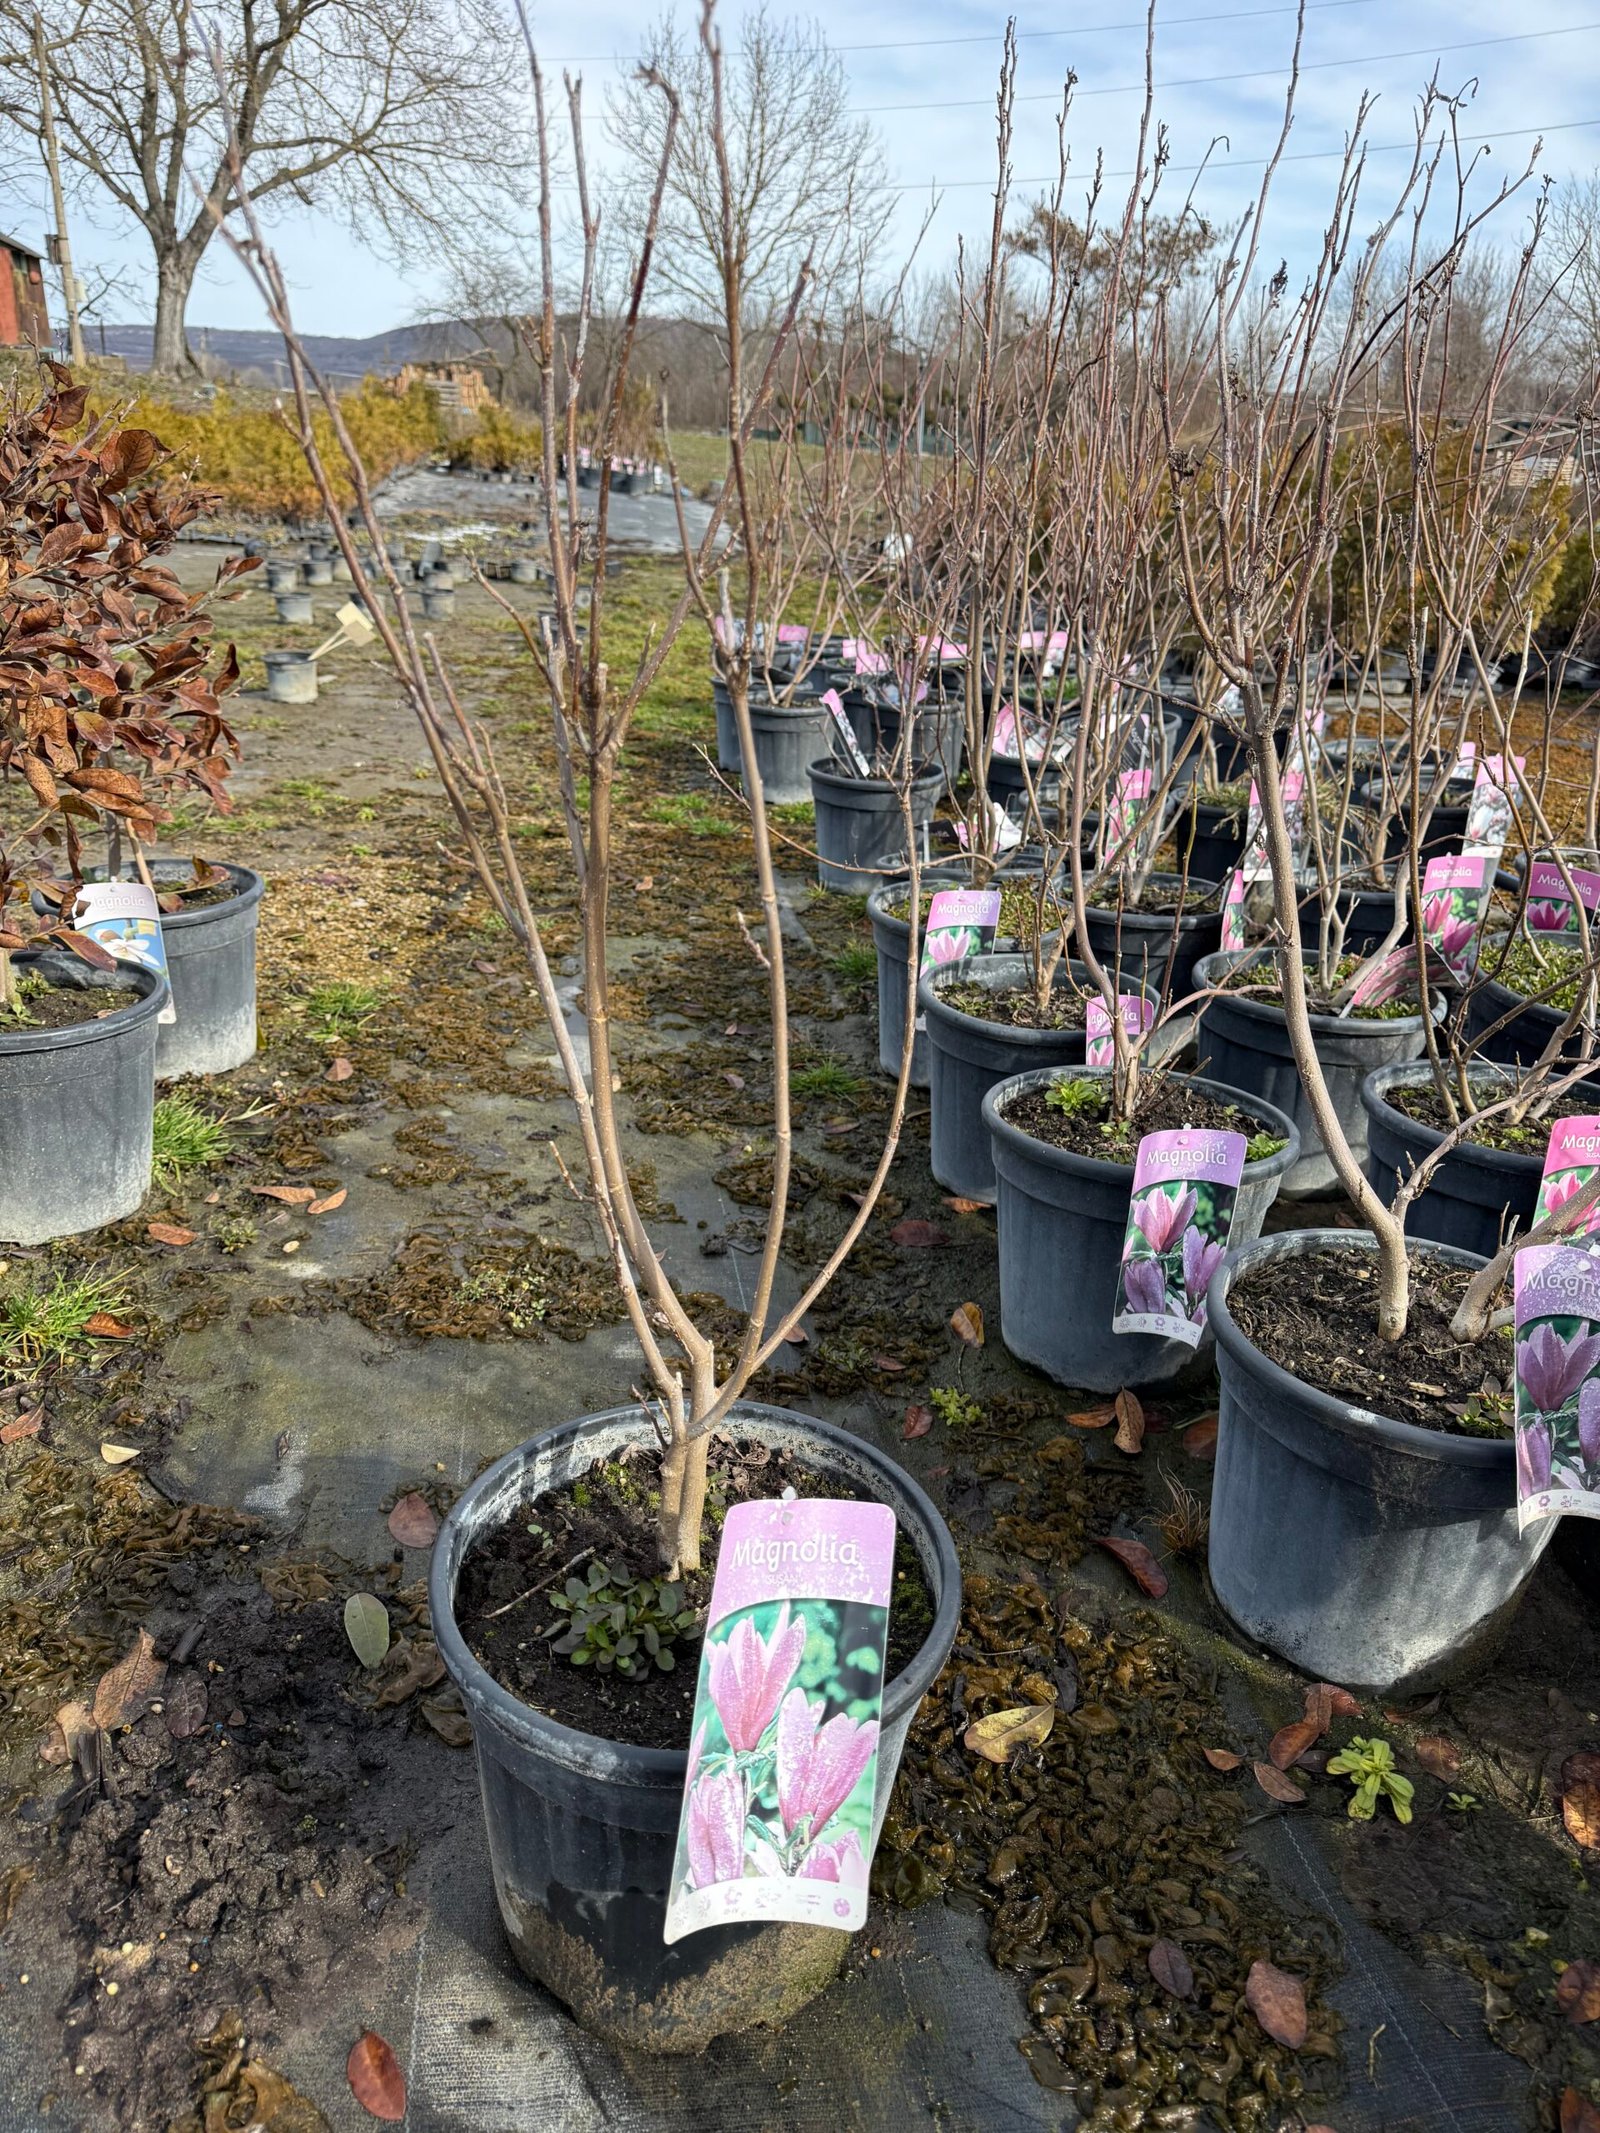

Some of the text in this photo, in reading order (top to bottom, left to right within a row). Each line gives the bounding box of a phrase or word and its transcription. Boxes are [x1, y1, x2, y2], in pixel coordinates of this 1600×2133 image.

[1537, 873, 1592, 896] Magolia
[936, 902, 989, 917] Magnolia
[1145, 1144, 1227, 1166] Magnolia
[730, 1533, 858, 1572] Magnolia
